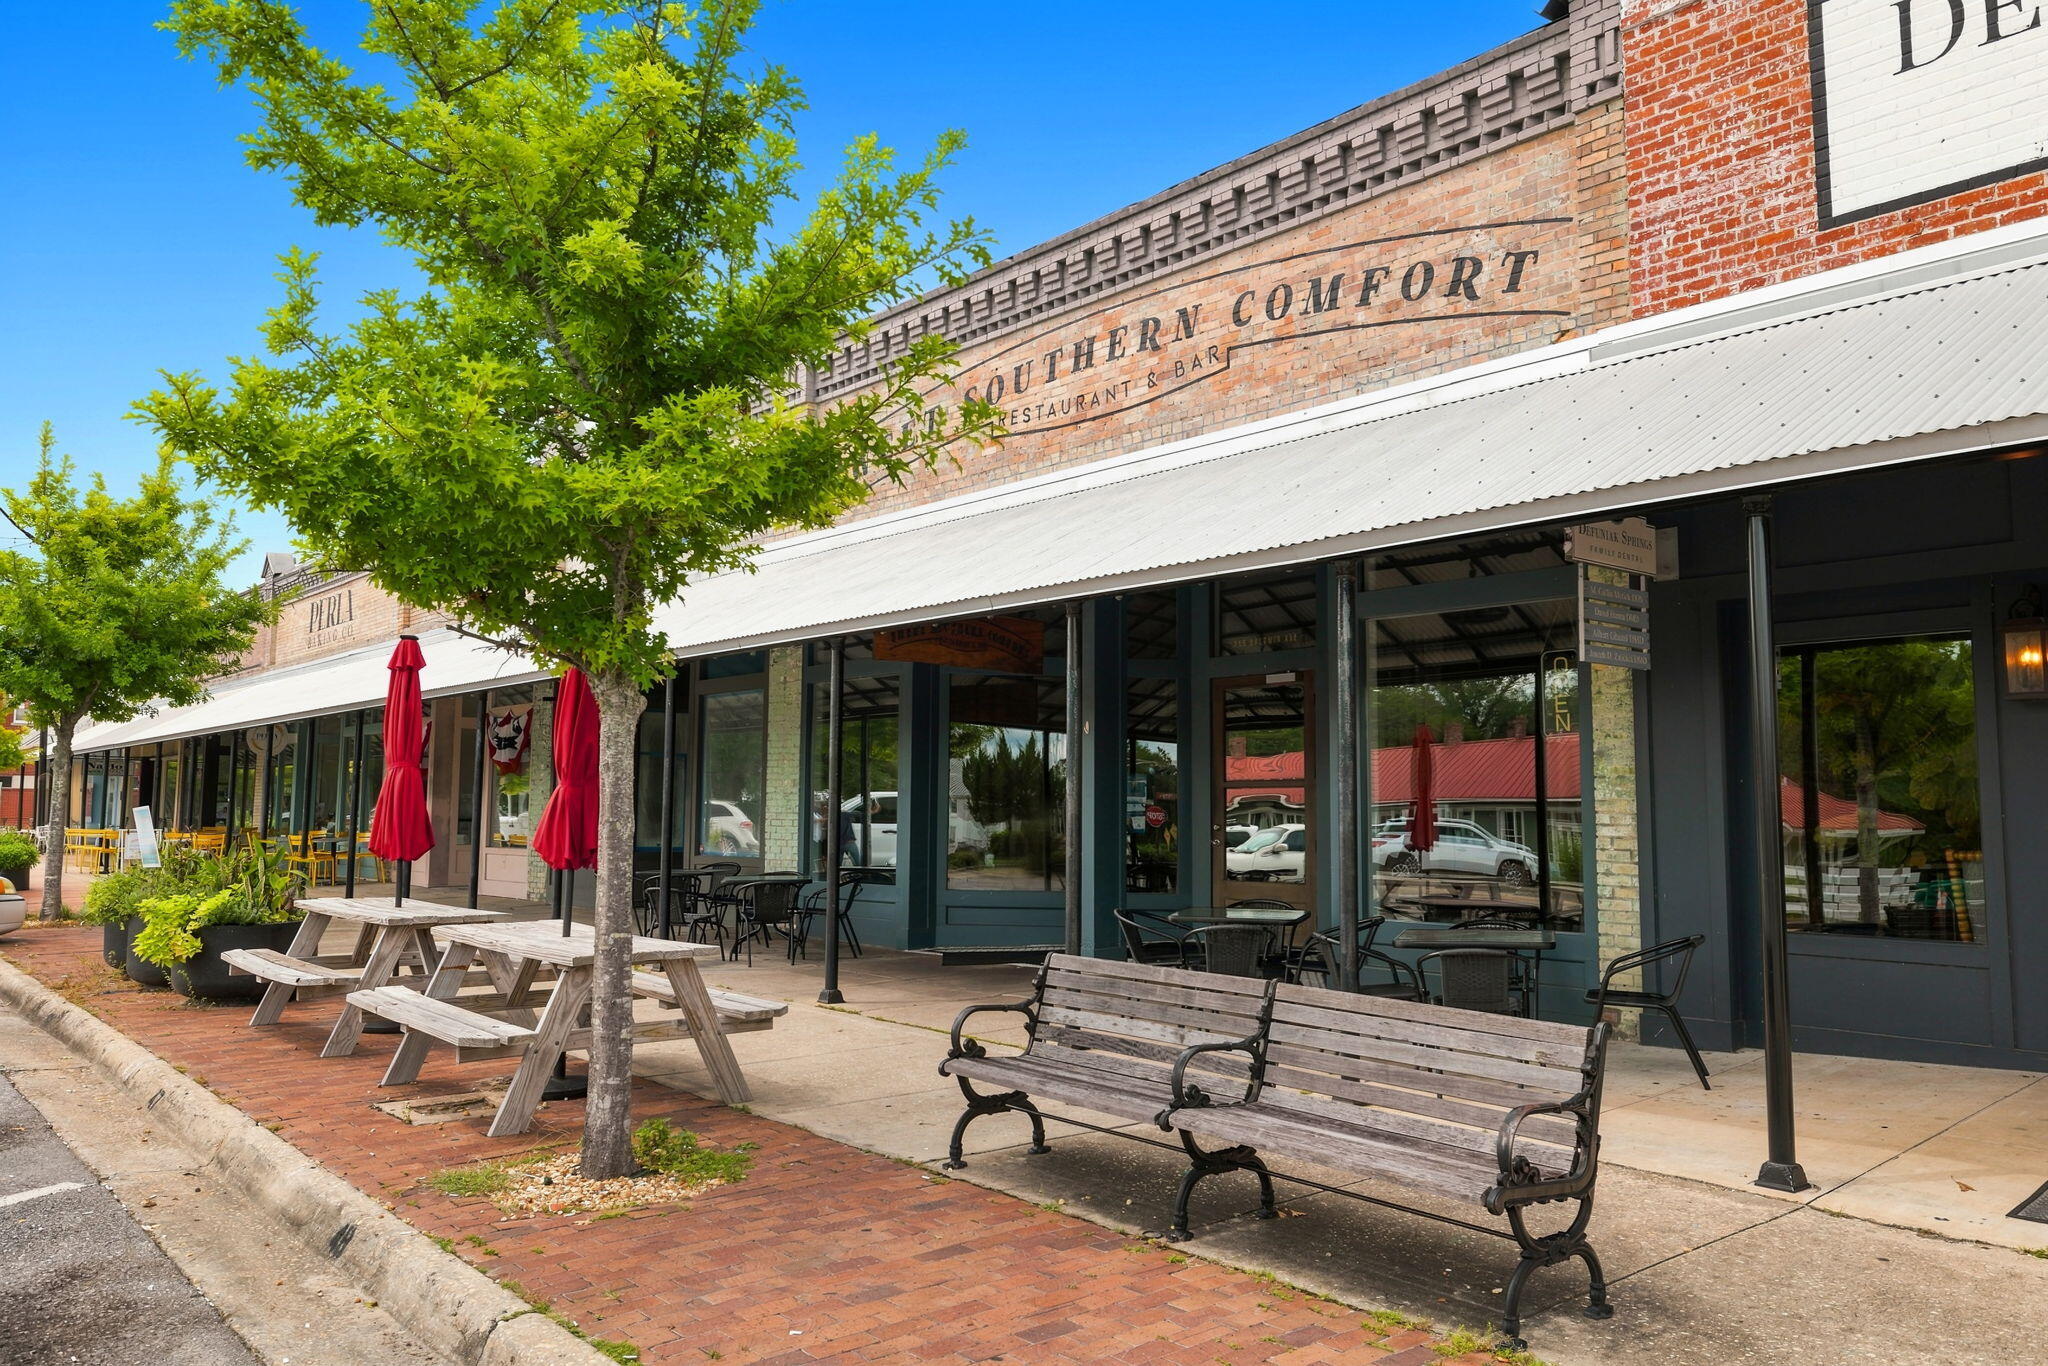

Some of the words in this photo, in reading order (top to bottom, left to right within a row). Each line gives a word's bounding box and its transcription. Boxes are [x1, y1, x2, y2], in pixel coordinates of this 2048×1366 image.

[964, 303, 1202, 407] SOUTHERN
[1232, 250, 1539, 327] COMFORT
[998, 379, 1132, 427] RESTAURANT
[1147, 371, 1159, 389] &
[1174, 345, 1219, 378] BAR
[309, 589, 354, 634] PERLA
